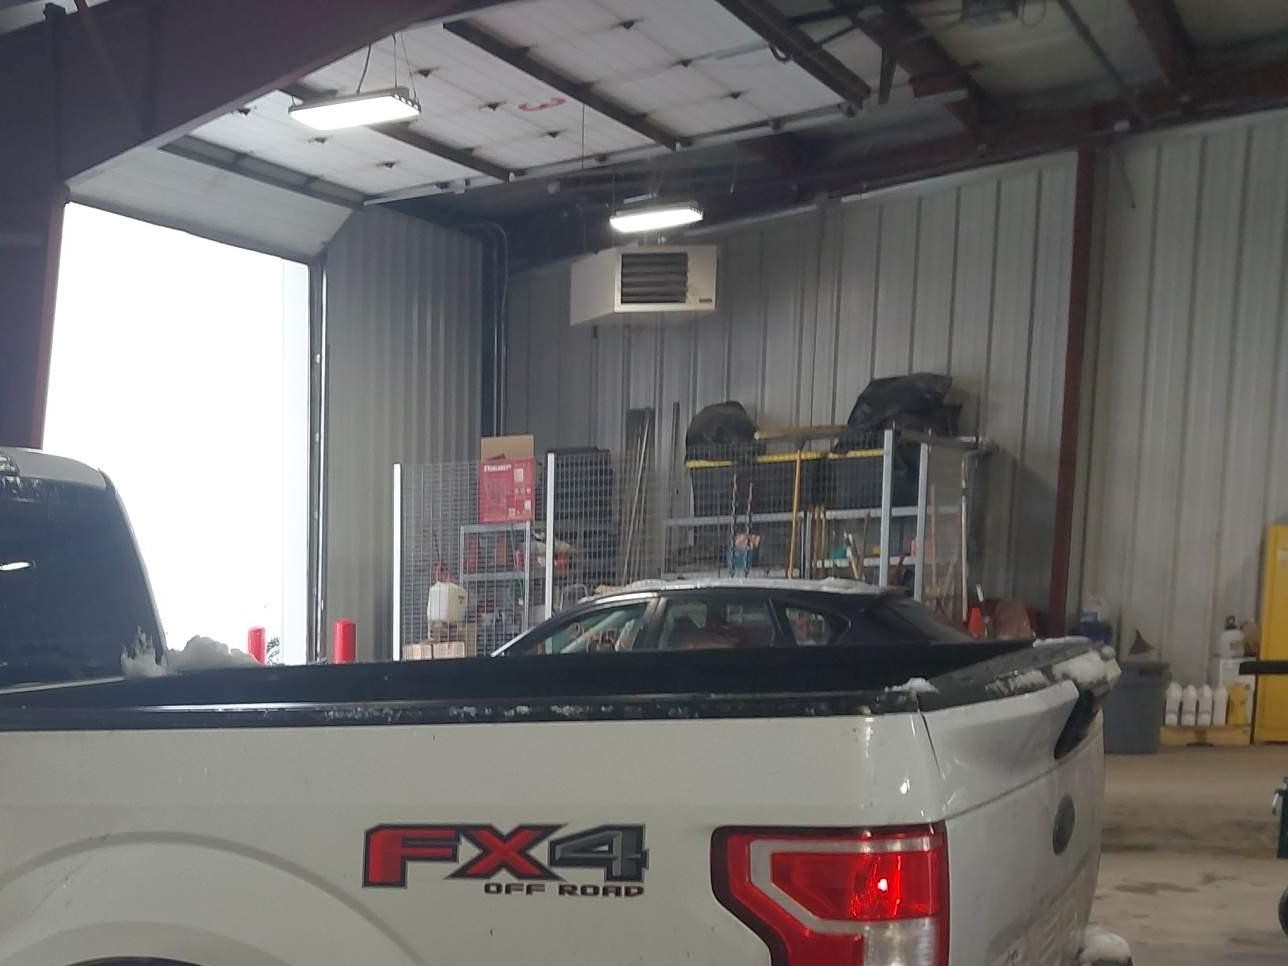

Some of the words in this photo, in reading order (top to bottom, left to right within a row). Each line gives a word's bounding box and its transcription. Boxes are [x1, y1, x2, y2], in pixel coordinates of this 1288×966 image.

[362, 823, 649, 888] FX4
[483, 882, 546, 896] OFF
[558, 883, 645, 898] ROAD
